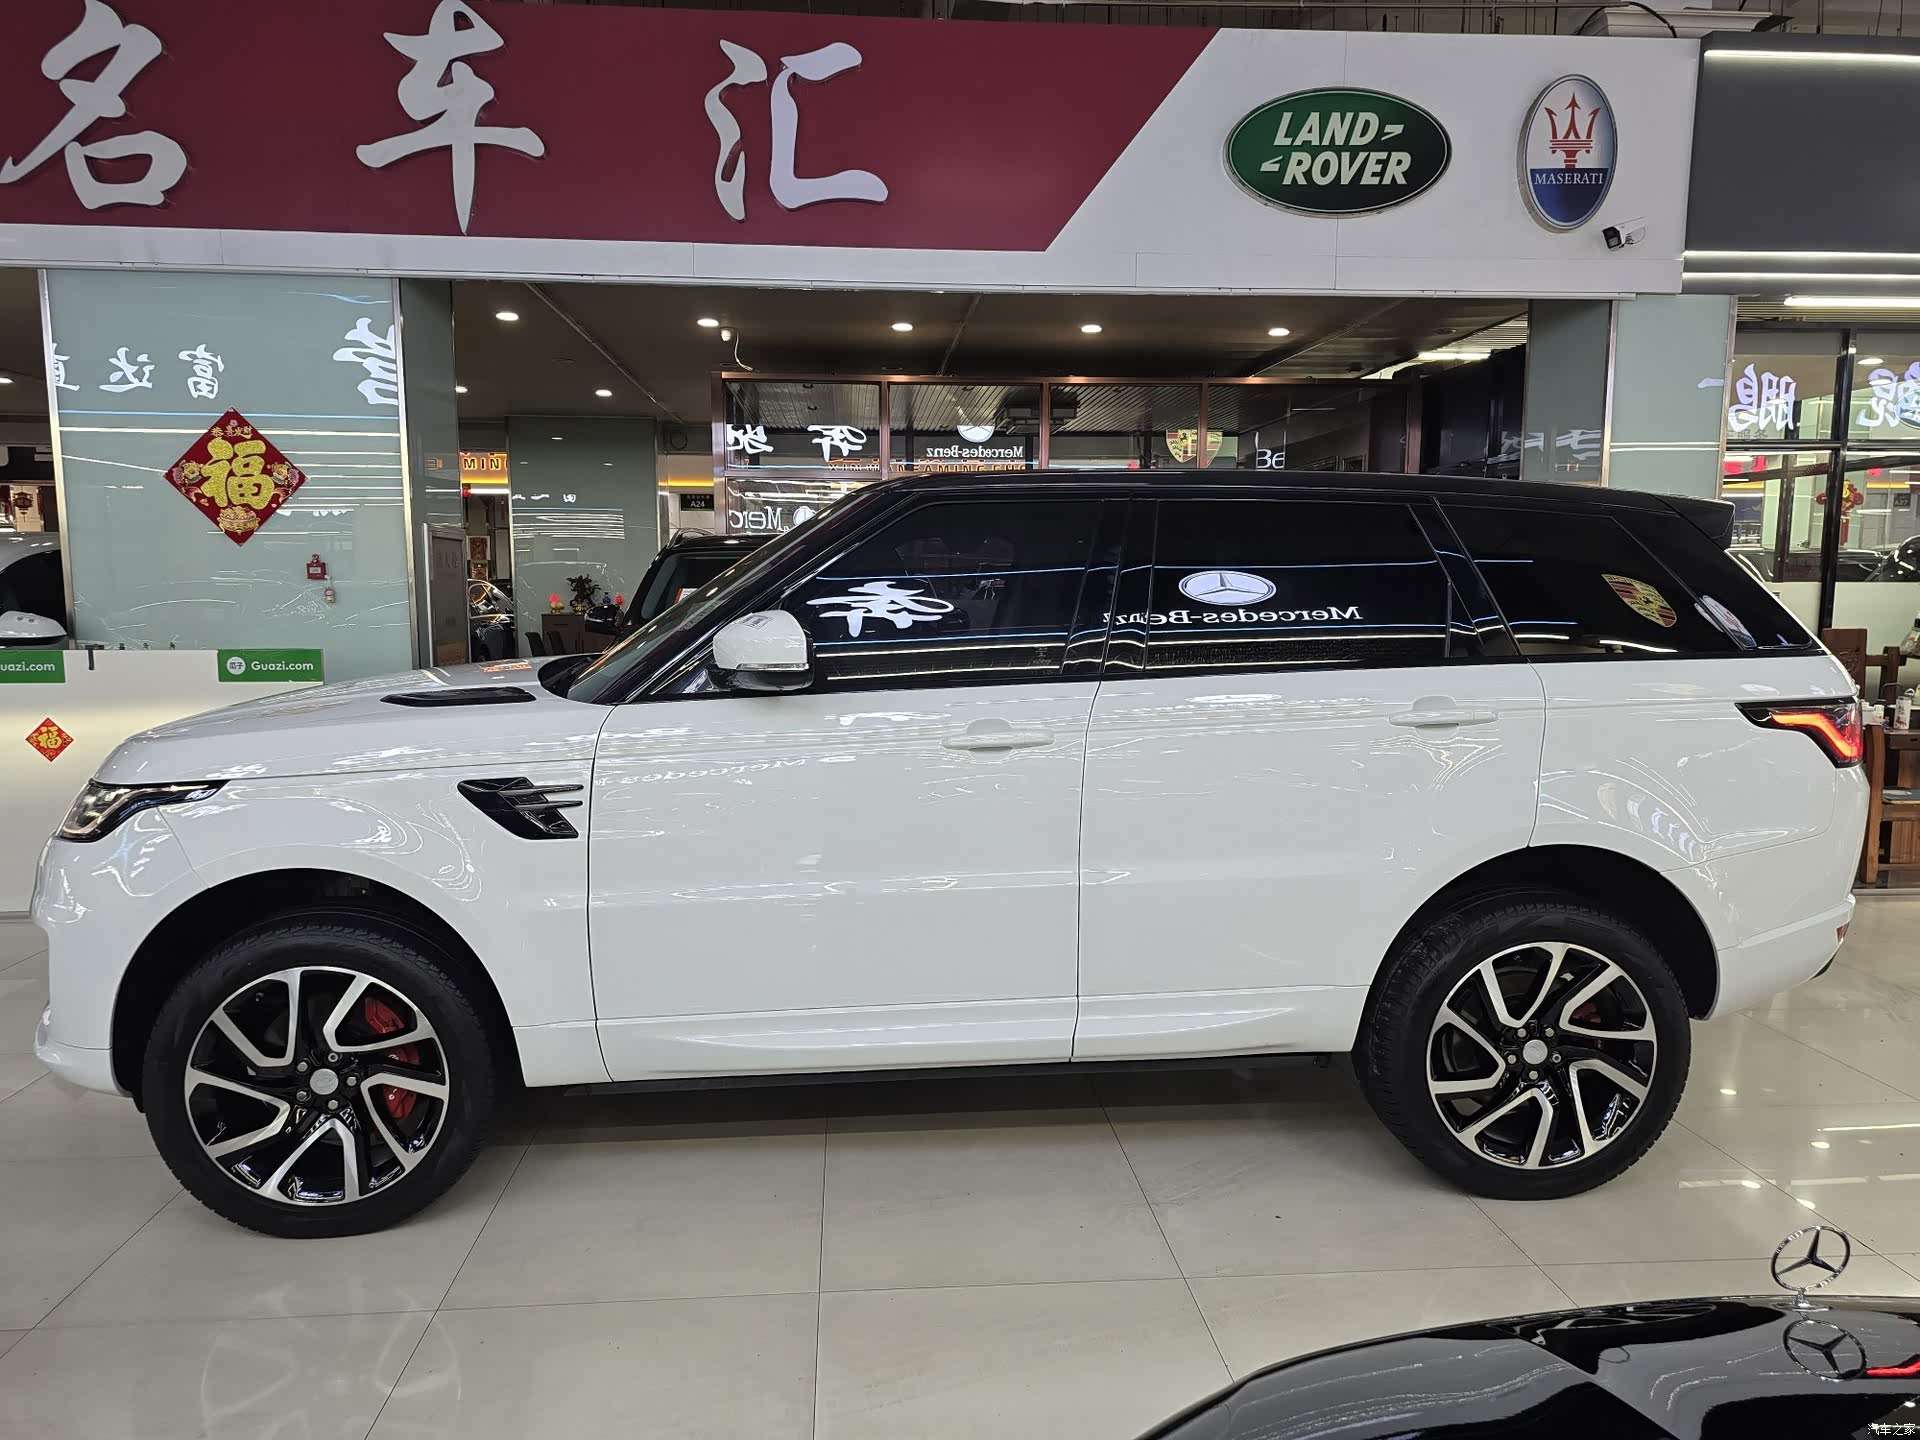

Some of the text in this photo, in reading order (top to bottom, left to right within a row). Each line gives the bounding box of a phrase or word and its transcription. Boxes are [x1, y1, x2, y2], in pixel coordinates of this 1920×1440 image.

[0, 0, 889, 236] 名车汇
[1273, 111, 1380, 146] LAND
[1281, 151, 1412, 185] ROVER
[1534, 172, 1604, 185] MASERATI
[200, 437, 275, 510] 福
[690, 500, 706, 508] A24
[250, 660, 315, 671] Guazi.com
